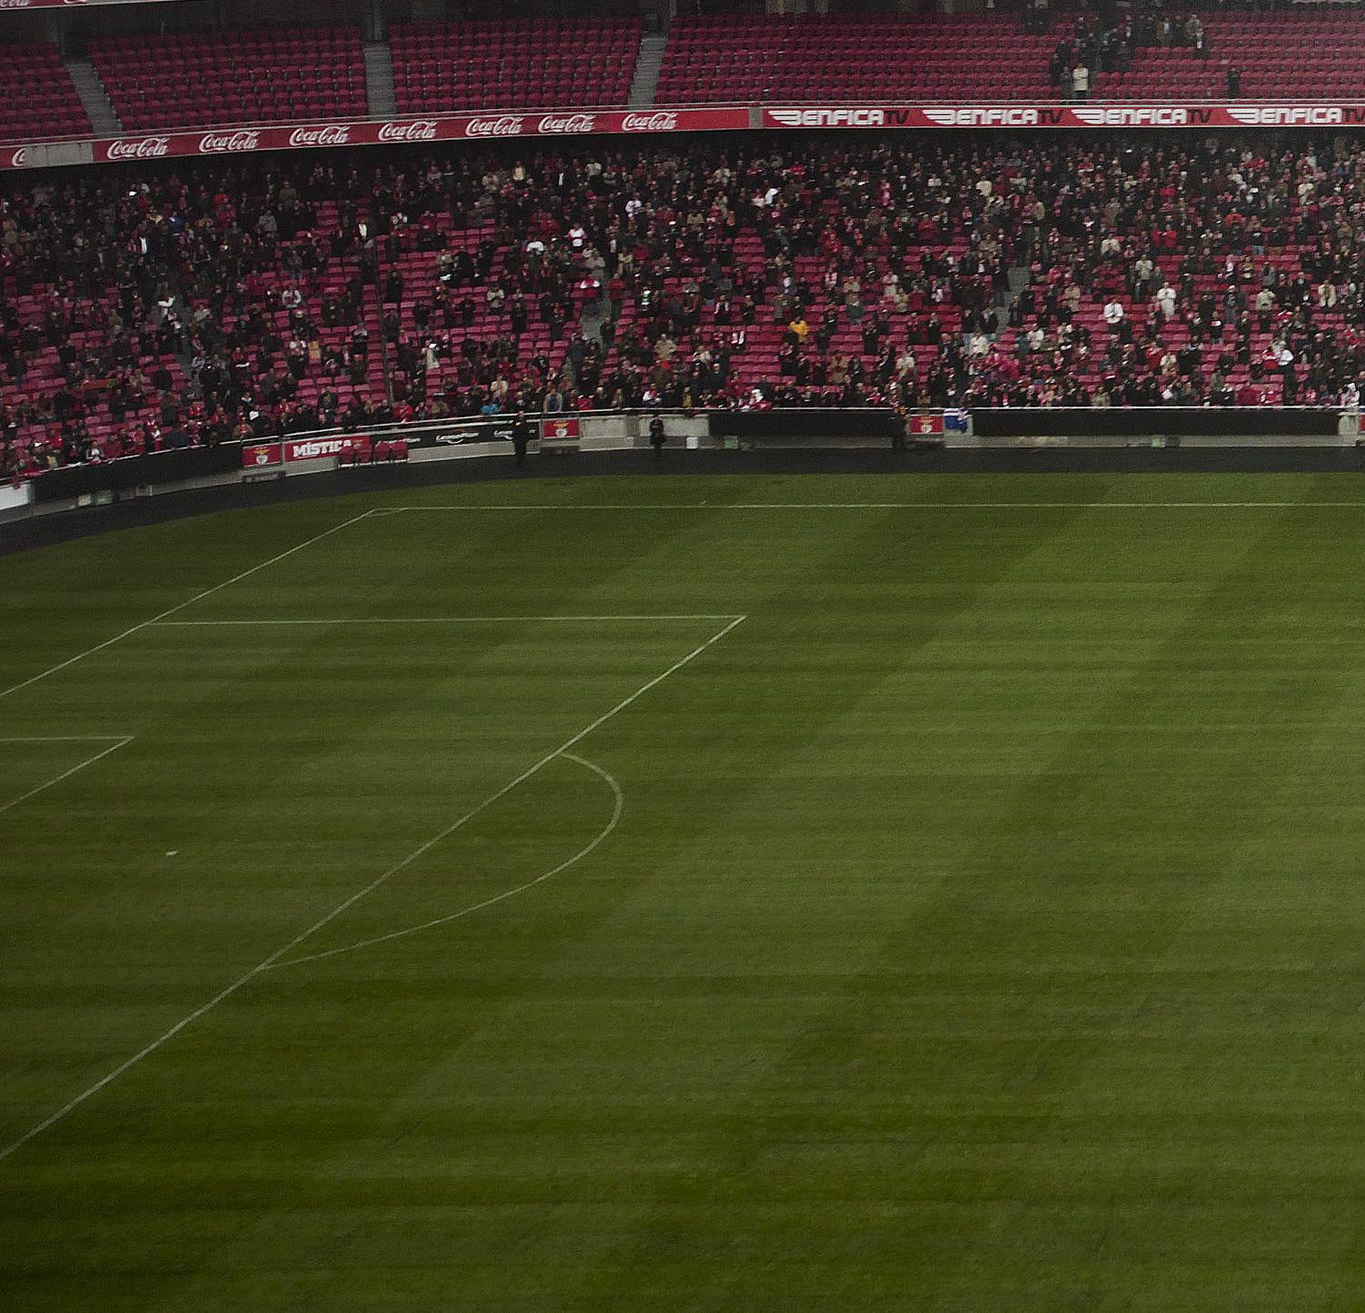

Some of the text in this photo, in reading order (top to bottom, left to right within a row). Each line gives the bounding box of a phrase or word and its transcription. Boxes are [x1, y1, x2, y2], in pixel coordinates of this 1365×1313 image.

[768, 109, 884, 125] BENFICA
[921, 108, 1038, 125] BENFICA
[1071, 108, 1188, 124] BENFICA
[1226, 107, 1343, 124] BENFICA
